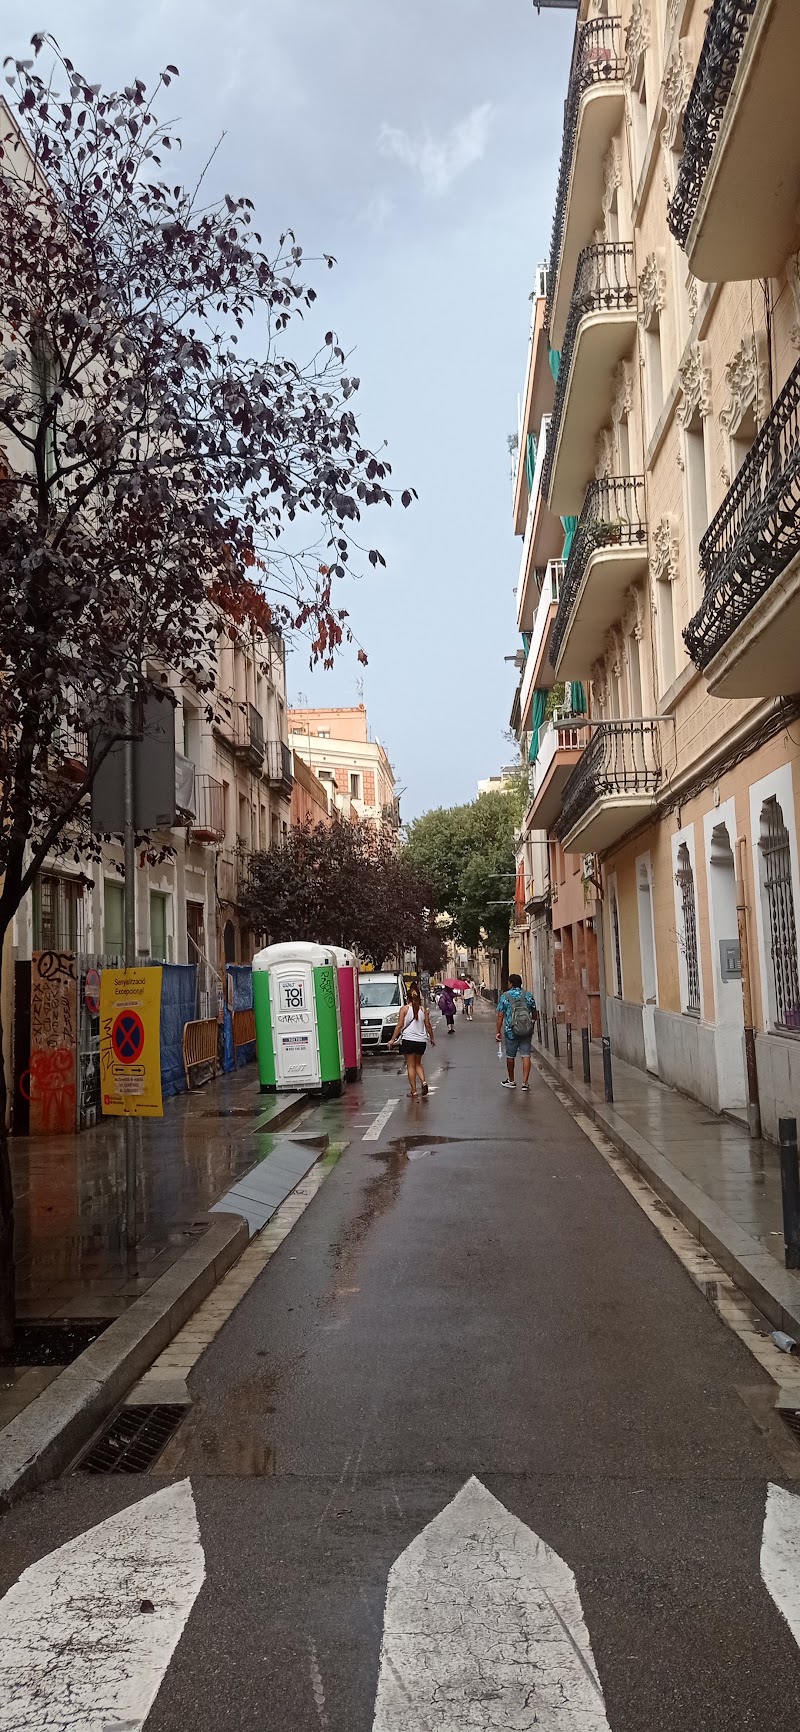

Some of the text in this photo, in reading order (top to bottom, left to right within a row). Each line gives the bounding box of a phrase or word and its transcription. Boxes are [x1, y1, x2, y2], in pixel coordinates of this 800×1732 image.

[114, 987, 145, 996] Excepcional
[284, 988, 302, 998] TOI
[285, 997, 303, 1007] TOI
